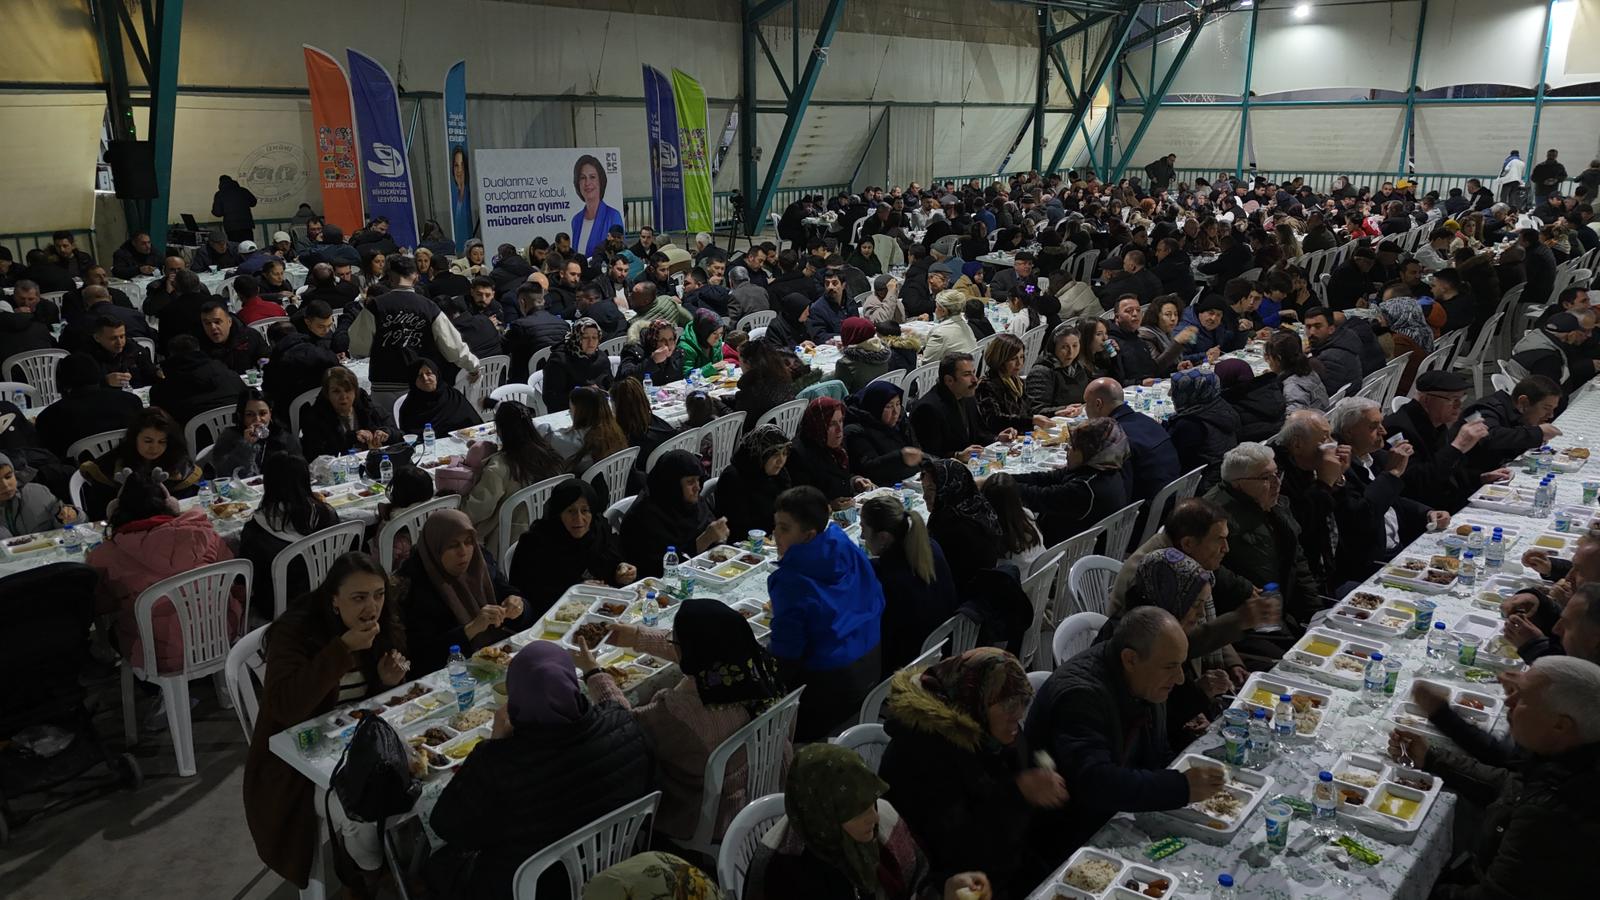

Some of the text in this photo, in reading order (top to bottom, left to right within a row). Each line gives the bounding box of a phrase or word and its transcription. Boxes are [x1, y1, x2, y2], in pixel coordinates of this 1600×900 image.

[483, 176, 548, 188] Dualarımız ve
[484, 186, 566, 201] oruçlarımız kabul,
[486, 202, 570, 214] Ramazan ayımız
[487, 214, 566, 228] mübarek olsun.
[382, 310, 426, 330] since
